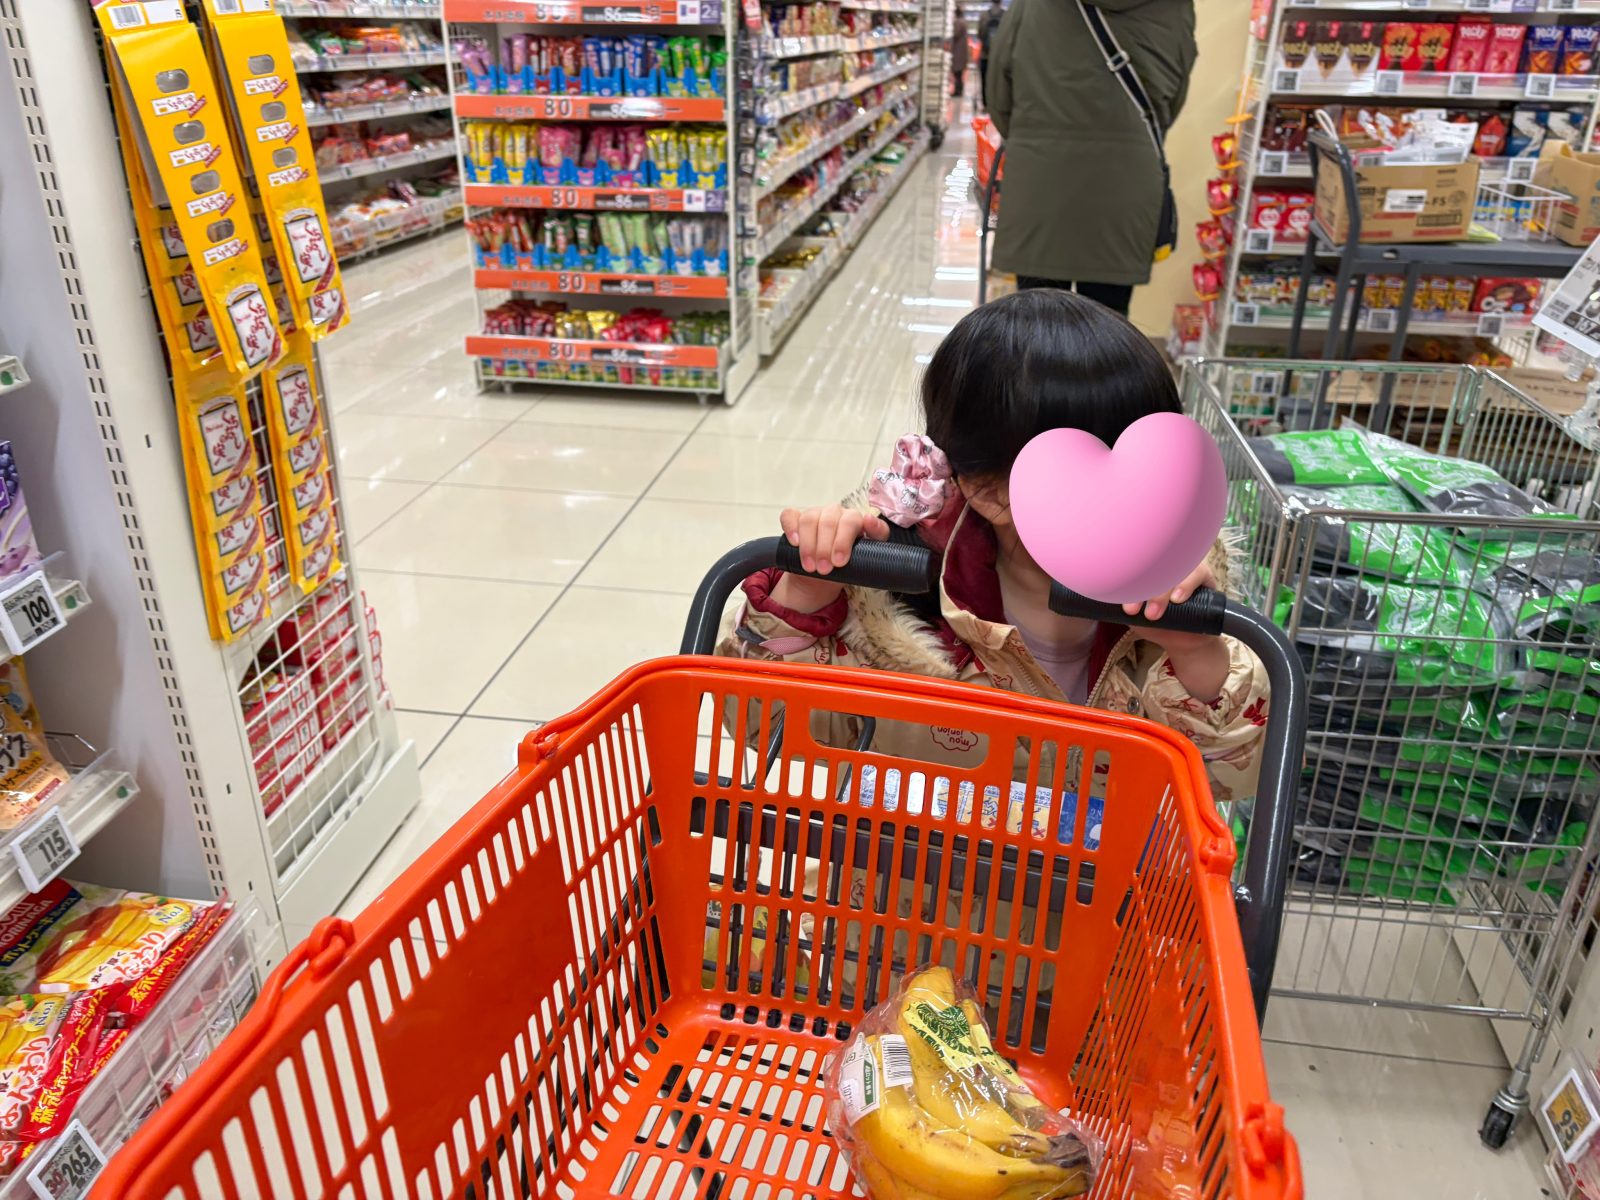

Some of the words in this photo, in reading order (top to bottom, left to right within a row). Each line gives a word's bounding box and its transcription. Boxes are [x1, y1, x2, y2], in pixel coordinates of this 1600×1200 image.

[21, 595, 51, 628] 100
[38, 829, 66, 863] 115
[35, 1001, 55, 1027] No.1
[61, 1143, 91, 1187] 265
